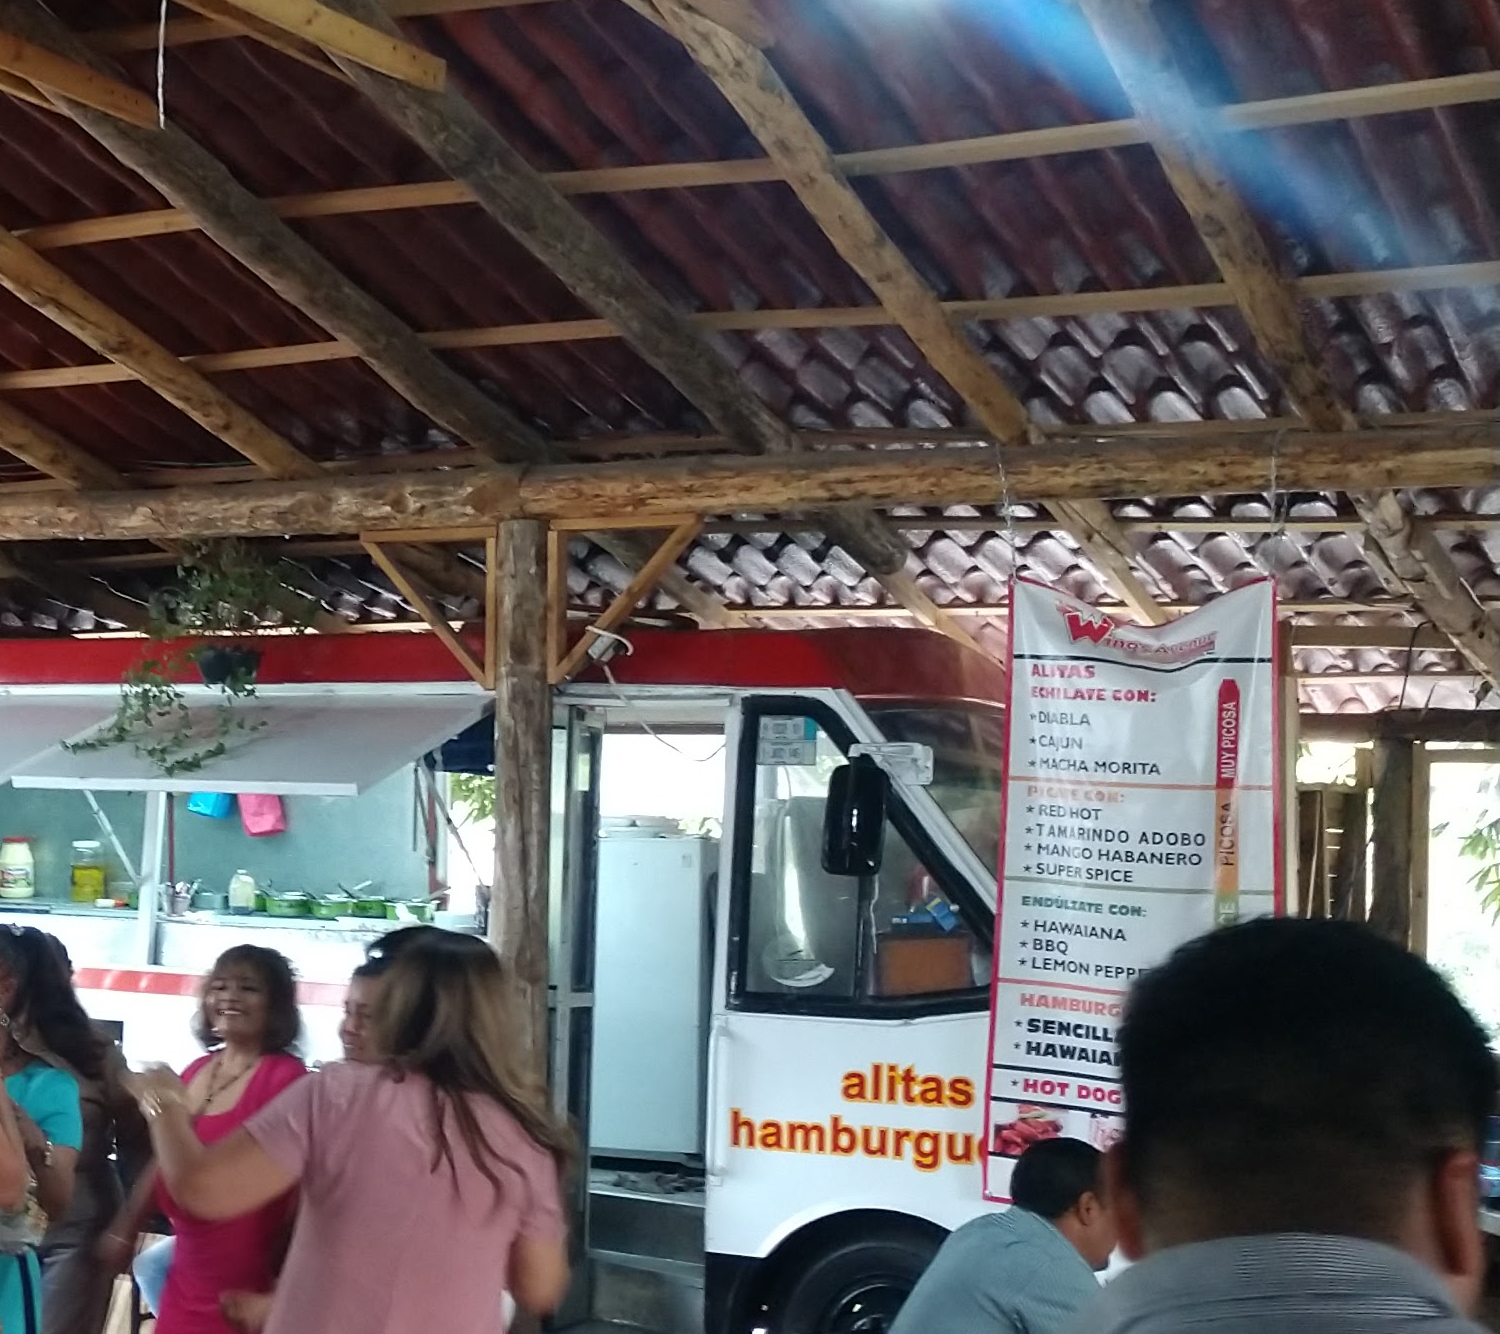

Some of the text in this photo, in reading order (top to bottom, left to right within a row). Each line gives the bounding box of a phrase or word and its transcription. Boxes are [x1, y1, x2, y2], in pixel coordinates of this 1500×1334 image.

[1032, 663, 1096, 679] ALITAS
[1112, 689, 1157, 703] CON:
[1039, 710, 1092, 727] DIABLA
[1038, 734, 1084, 752] CAJUN
[1220, 701, 1237, 779] MUY PICOSA
[1040, 757, 1162, 776] MACHA MORITA
[1038, 804, 1103, 821] RED HOT
[1036, 823, 1206, 847] TAMARINDO ADOBO
[1219, 801, 1236, 866] PICOSA
[1037, 843, 1203, 867] MANGO HABANERO
[1035, 862, 1134, 883] SUPER SPICE
[1107, 903, 1148, 918] CON:
[1033, 919, 1128, 942] HAWAIANA
[1032, 938, 1069, 955] BBQ
[1031, 956, 1090, 975] LEMON
[1020, 992, 1125, 1018] HAMBURG
[1026, 1018, 1119, 1043] SENCILL
[841, 1062, 976, 1109] alitas
[1022, 1077, 1122, 1105] HOT DOG
